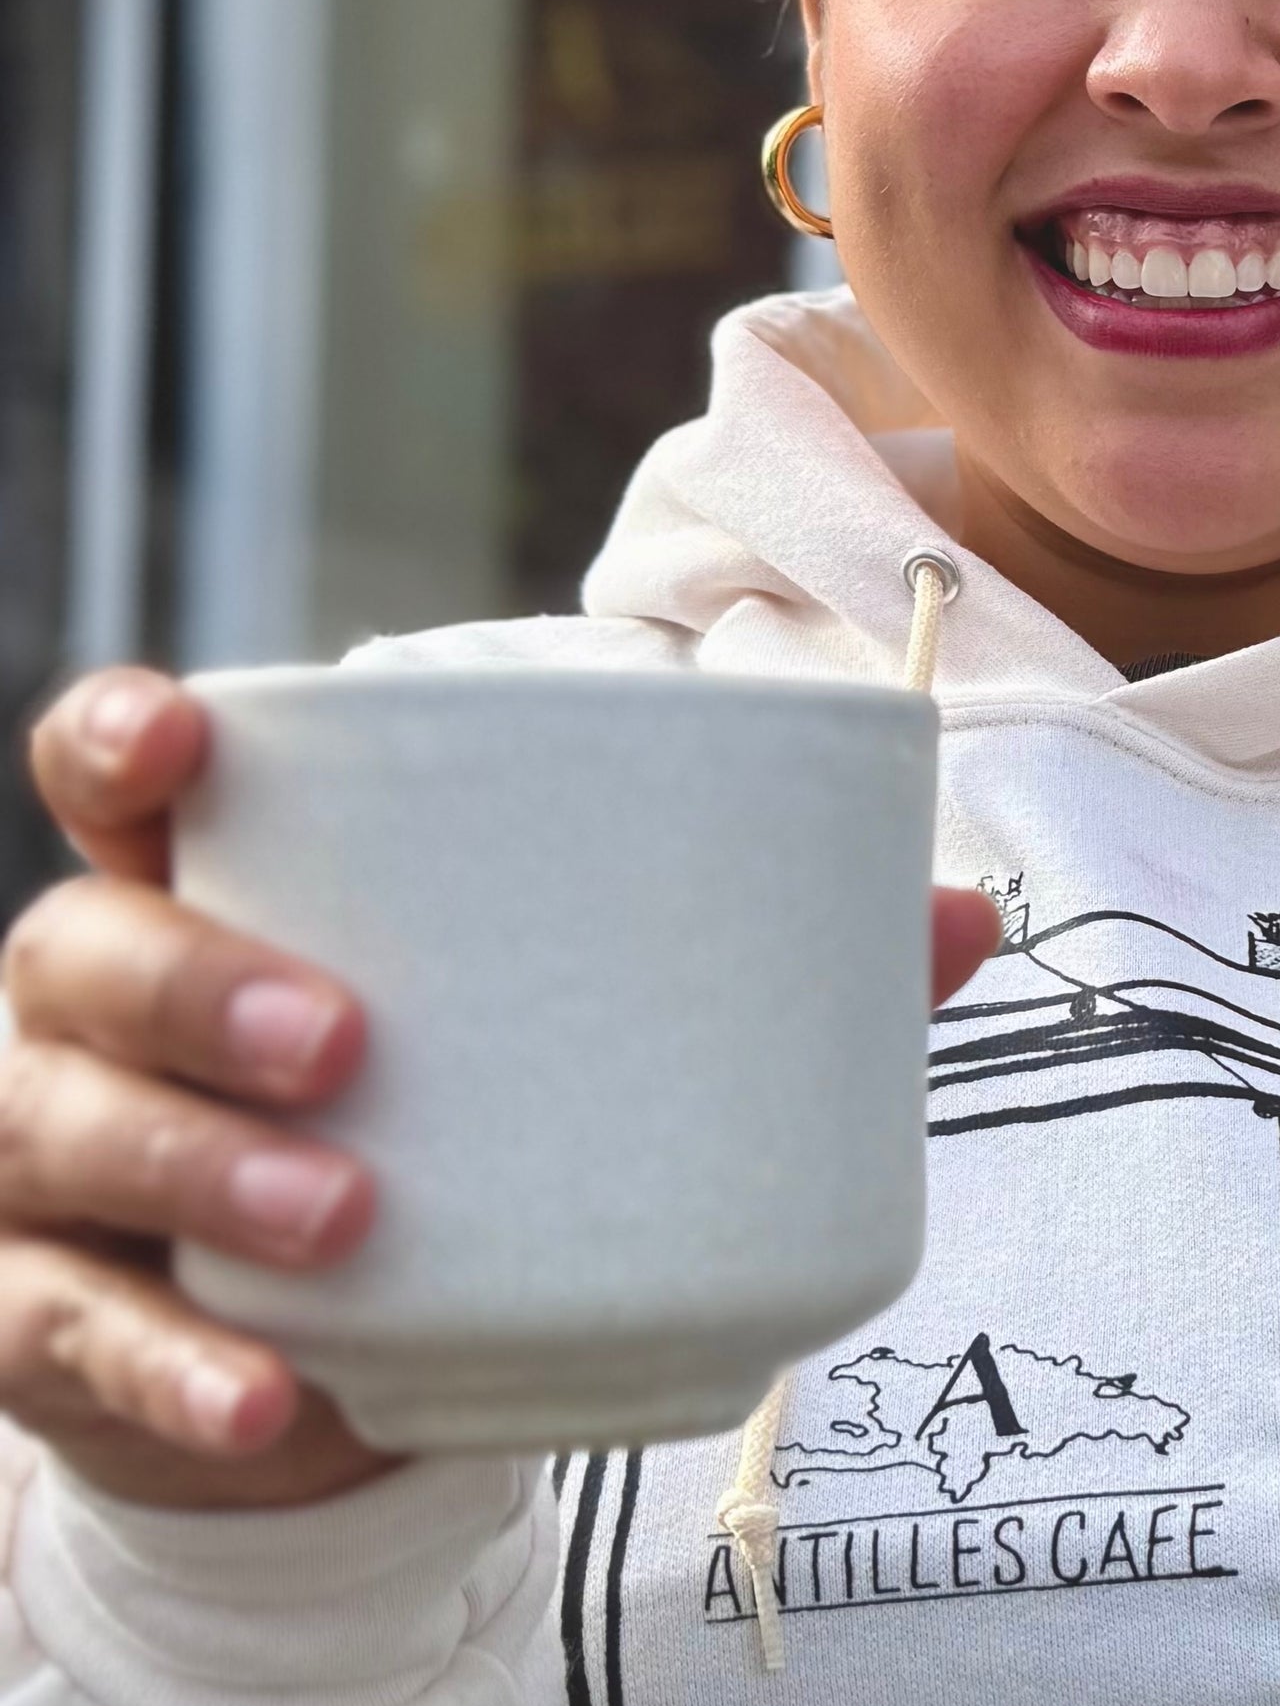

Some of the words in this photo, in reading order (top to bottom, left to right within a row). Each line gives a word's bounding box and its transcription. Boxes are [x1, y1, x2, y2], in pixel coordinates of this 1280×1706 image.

[915, 1332, 1029, 1441] A
[705, 1515, 1025, 1613] ANTILLES
[1052, 1500, 1223, 1583] CAFE
